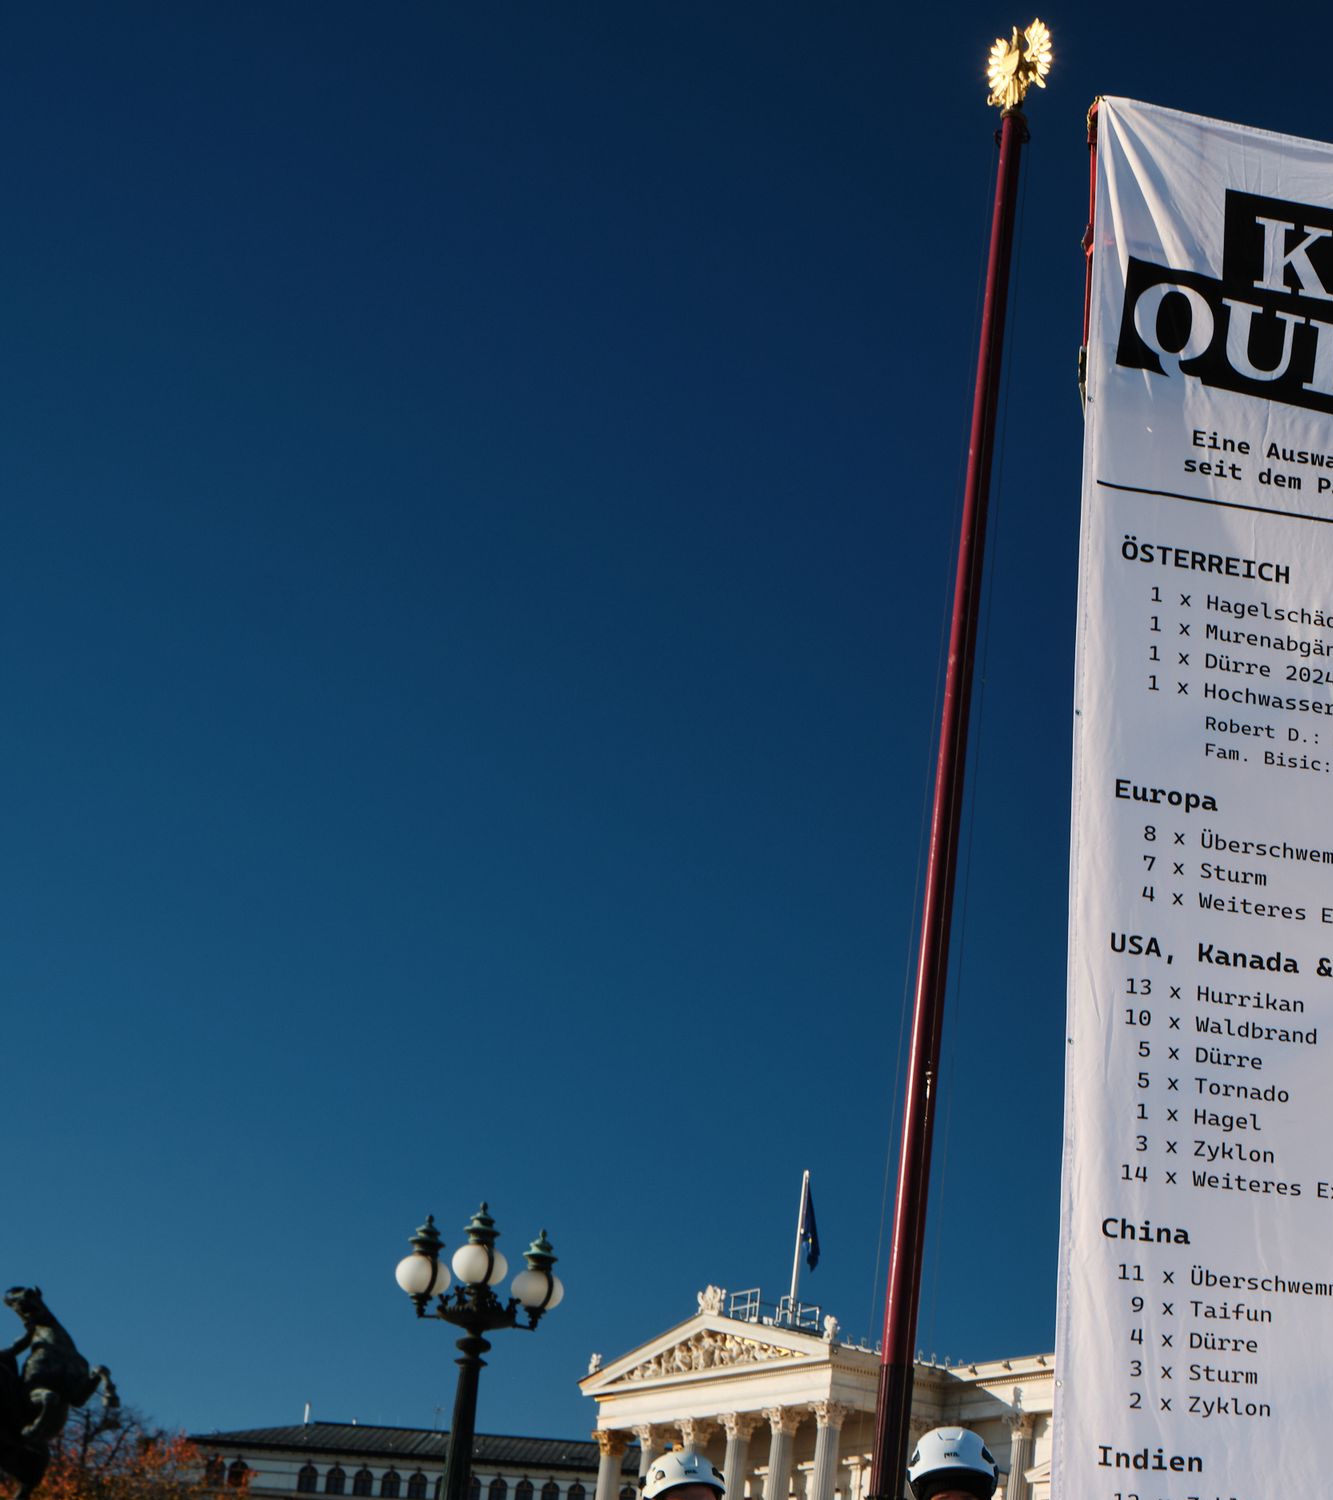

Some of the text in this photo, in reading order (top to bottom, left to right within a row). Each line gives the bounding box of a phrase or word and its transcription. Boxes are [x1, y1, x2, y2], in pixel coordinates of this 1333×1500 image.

[1193, 430, 1250, 454] Eine
[1185, 460, 1241, 480] seit
[1258, 468, 1301, 490] dem
[1122, 535, 1289, 584] ÖSTERREICH
[1151, 587, 1162, 602] 1
[1180, 594, 1191, 607] x
[1151, 616, 1161, 632] 1
[1179, 623, 1190, 636] x
[1149, 646, 1160, 661] 1
[1179, 653, 1189, 665] x
[1205, 653, 1270, 677] Dürre
[1149, 675, 1159, 691] 1
[1178, 682, 1188, 695] x
[1206, 716, 1275, 739] Robert
[1288, 728, 1318, 744] D.:
[1206, 743, 1247, 761] Fam.
[1265, 751, 1329, 772] Bisic:
[1116, 779, 1218, 813] Europa
[1144, 825, 1156, 841] 8
[1174, 832, 1185, 845] x
[1142, 886, 1155, 902] 4
[1173, 893, 1183, 905] x
[1199, 892, 1305, 920] Weiteres
[1111, 932, 1173, 965] USA,
[1198, 942, 1299, 974] Kanada
[1316, 957, 1333, 978] &
[1126, 978, 1304, 1013] 13 x Hurrikan
[1125, 1009, 1317, 1045] 10 x Waldbrand
[1137, 1103, 1261, 1132] 1 x Hagel
[1121, 1164, 1148, 1183] 14
[1166, 1171, 1177, 1184] x
[1192, 1170, 1301, 1196] Weiteres
[1102, 1217, 1190, 1245] China
[1118, 1263, 1144, 1282] 11
[1163, 1271, 1174, 1284] x
[1131, 1296, 1272, 1323] 9 x Taifun
[1098, 1445, 1203, 1472] Indien
